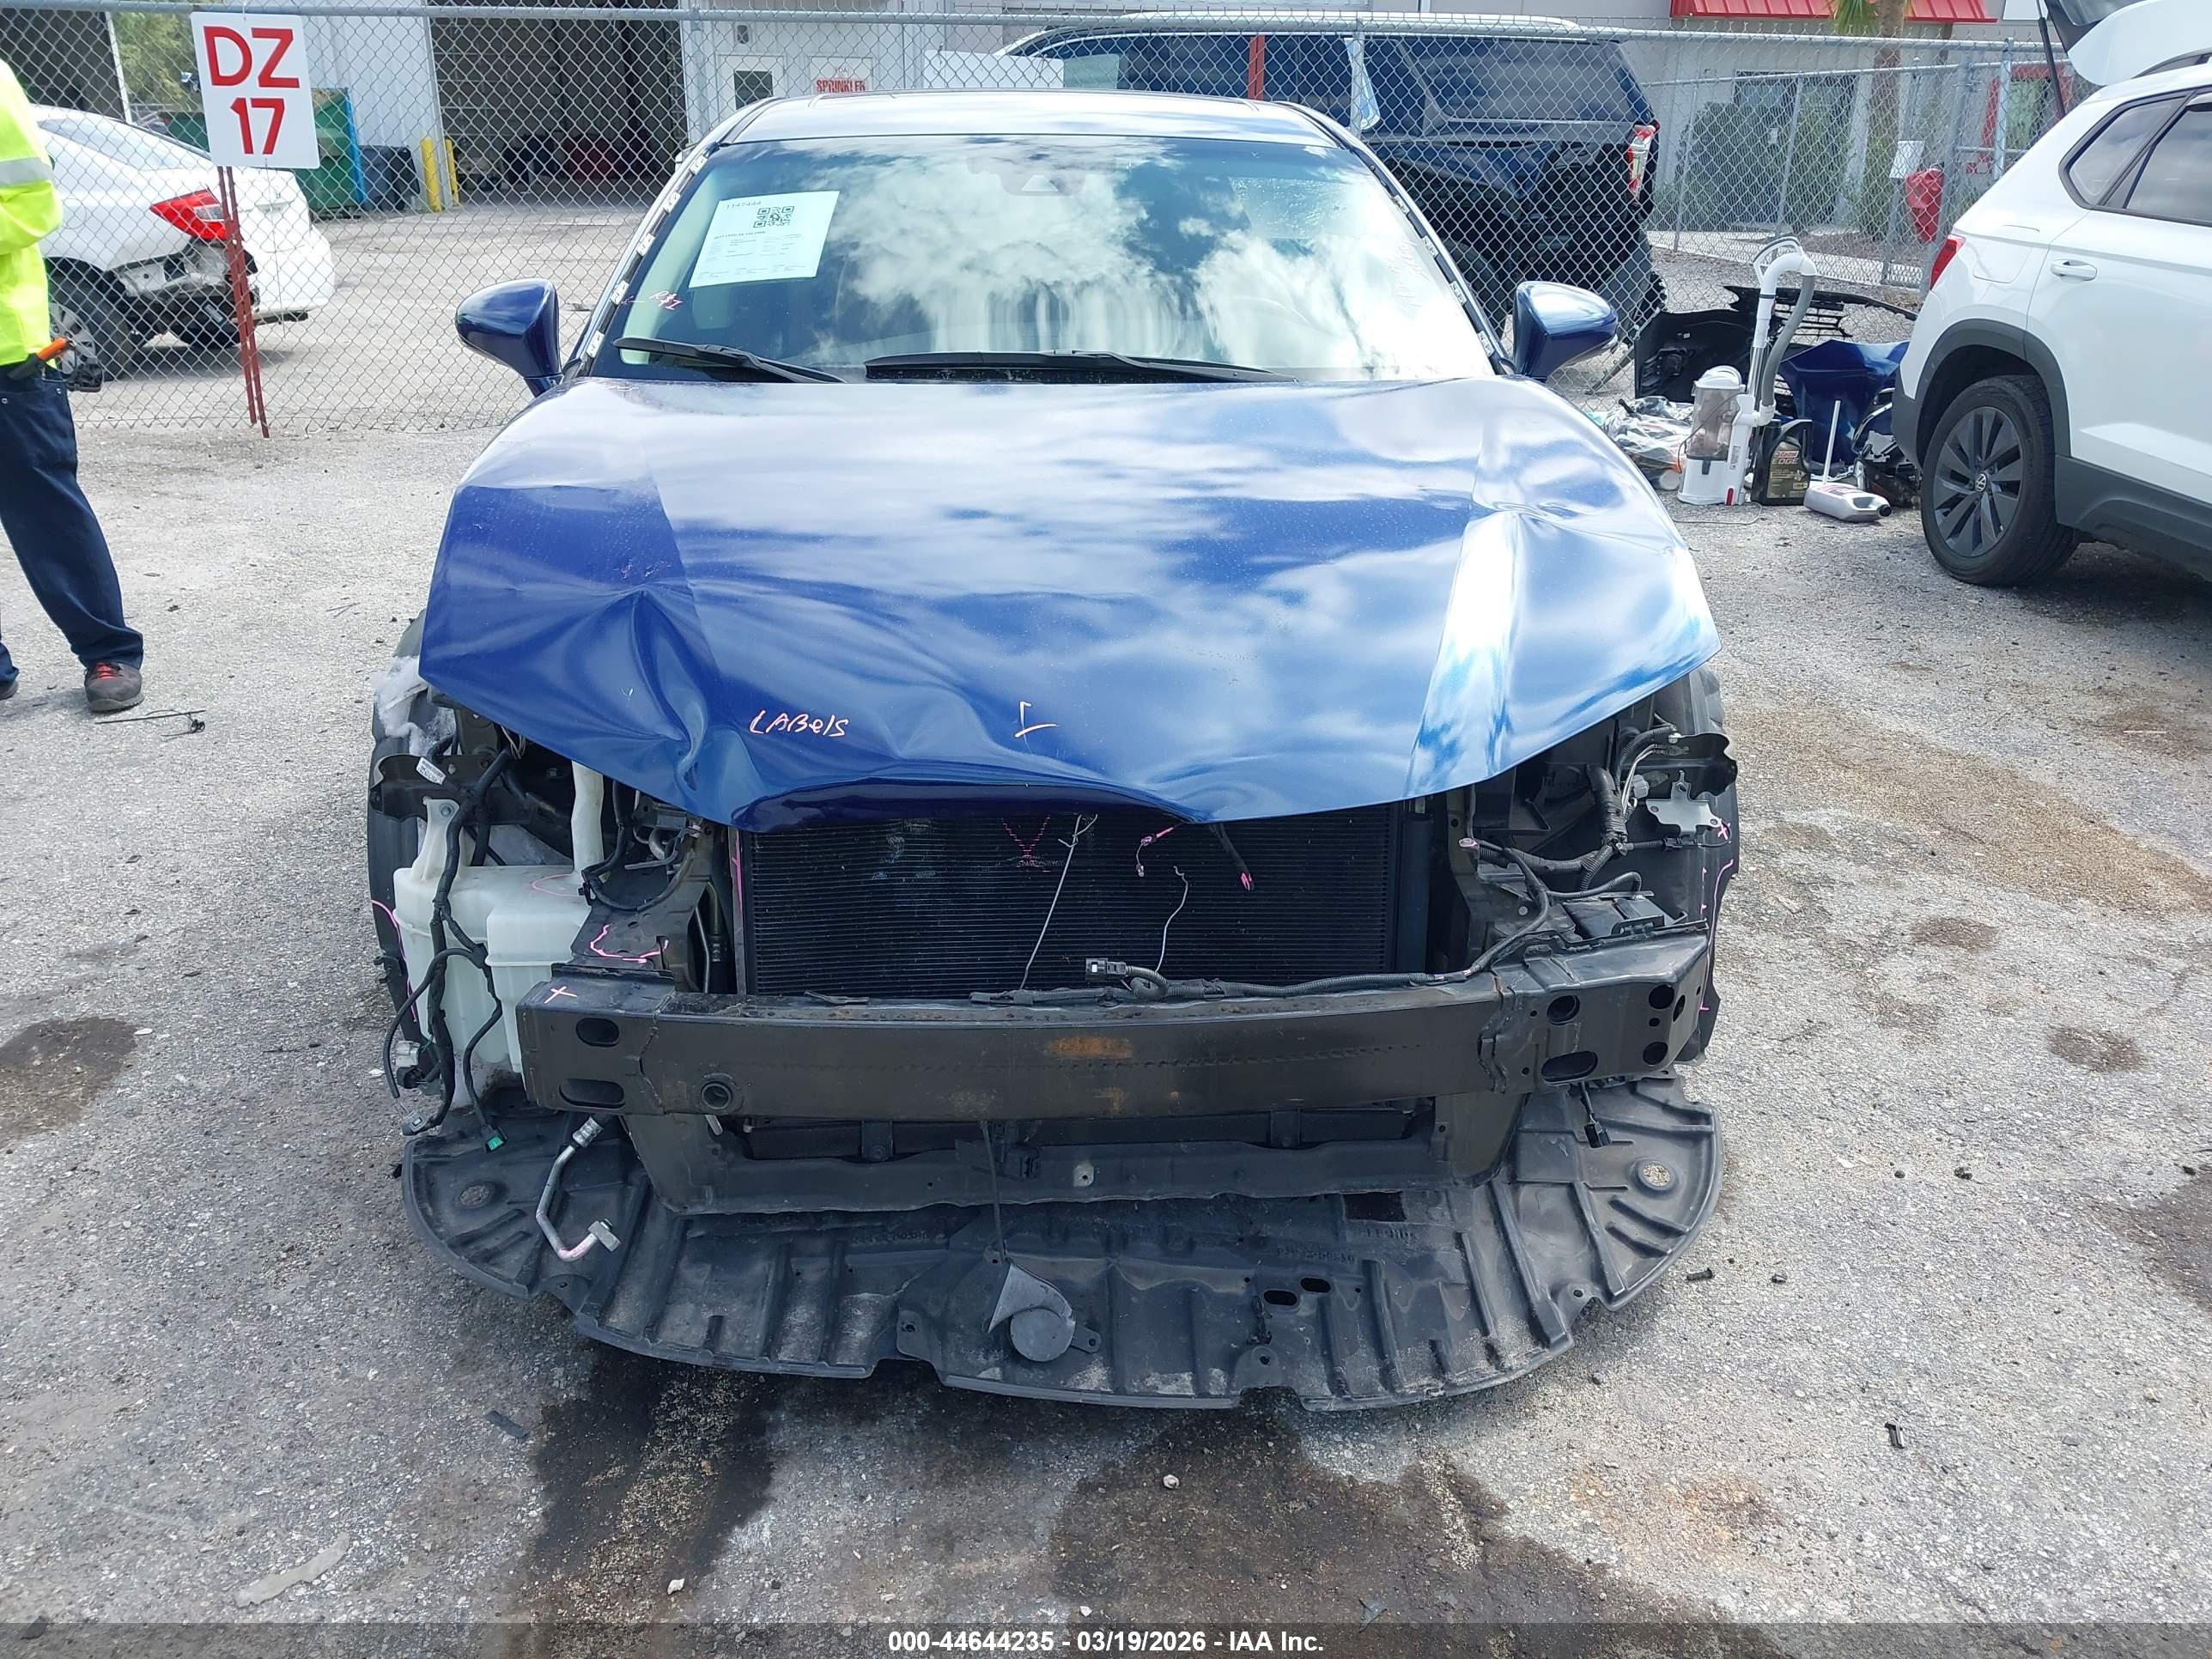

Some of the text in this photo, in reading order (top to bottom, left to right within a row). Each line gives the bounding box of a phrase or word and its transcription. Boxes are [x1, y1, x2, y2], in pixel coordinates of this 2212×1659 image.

[203, 26, 301, 89] DZ
[816, 79, 866, 93] SPRINKLER
[229, 97, 285, 155] 17
